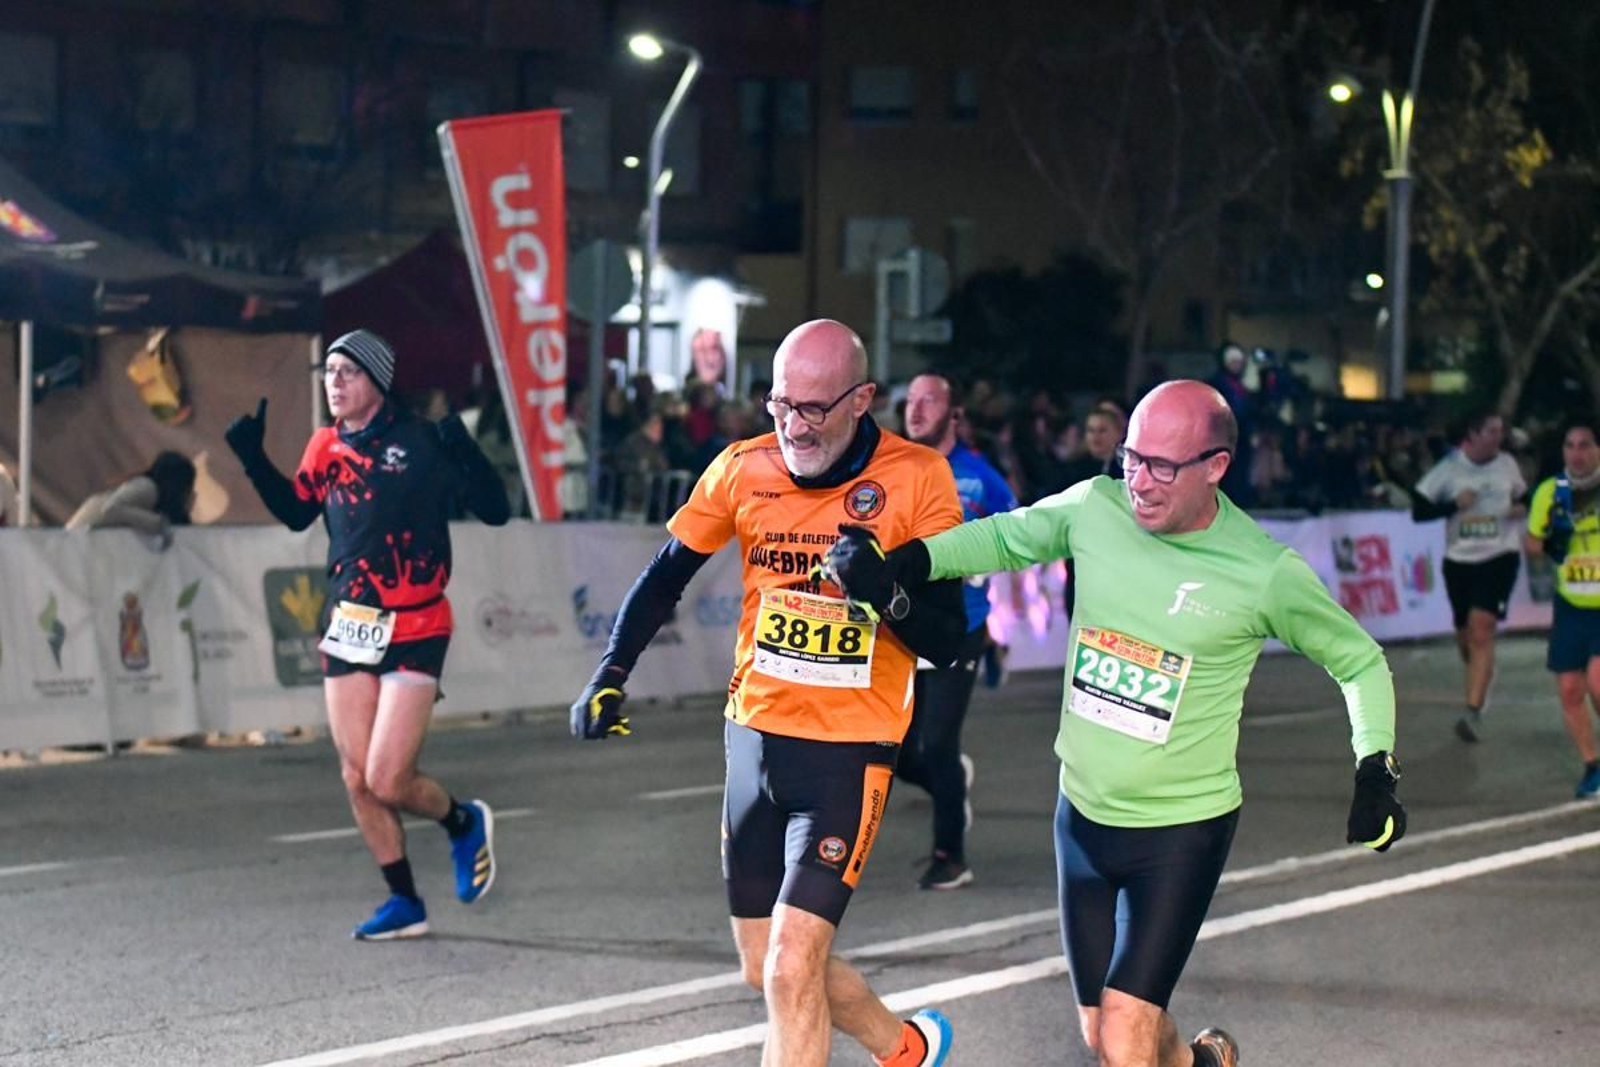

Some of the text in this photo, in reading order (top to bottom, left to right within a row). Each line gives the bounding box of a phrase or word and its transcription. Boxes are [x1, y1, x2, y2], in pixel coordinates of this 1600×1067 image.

[765, 532, 785, 543] CLUB
[788, 533, 799, 543] DE
[784, 595, 802, 611] 42
[338, 618, 383, 644] 9660
[764, 613, 861, 654] 3818
[1099, 631, 1118, 650] 42
[1077, 648, 1171, 710] 2932
